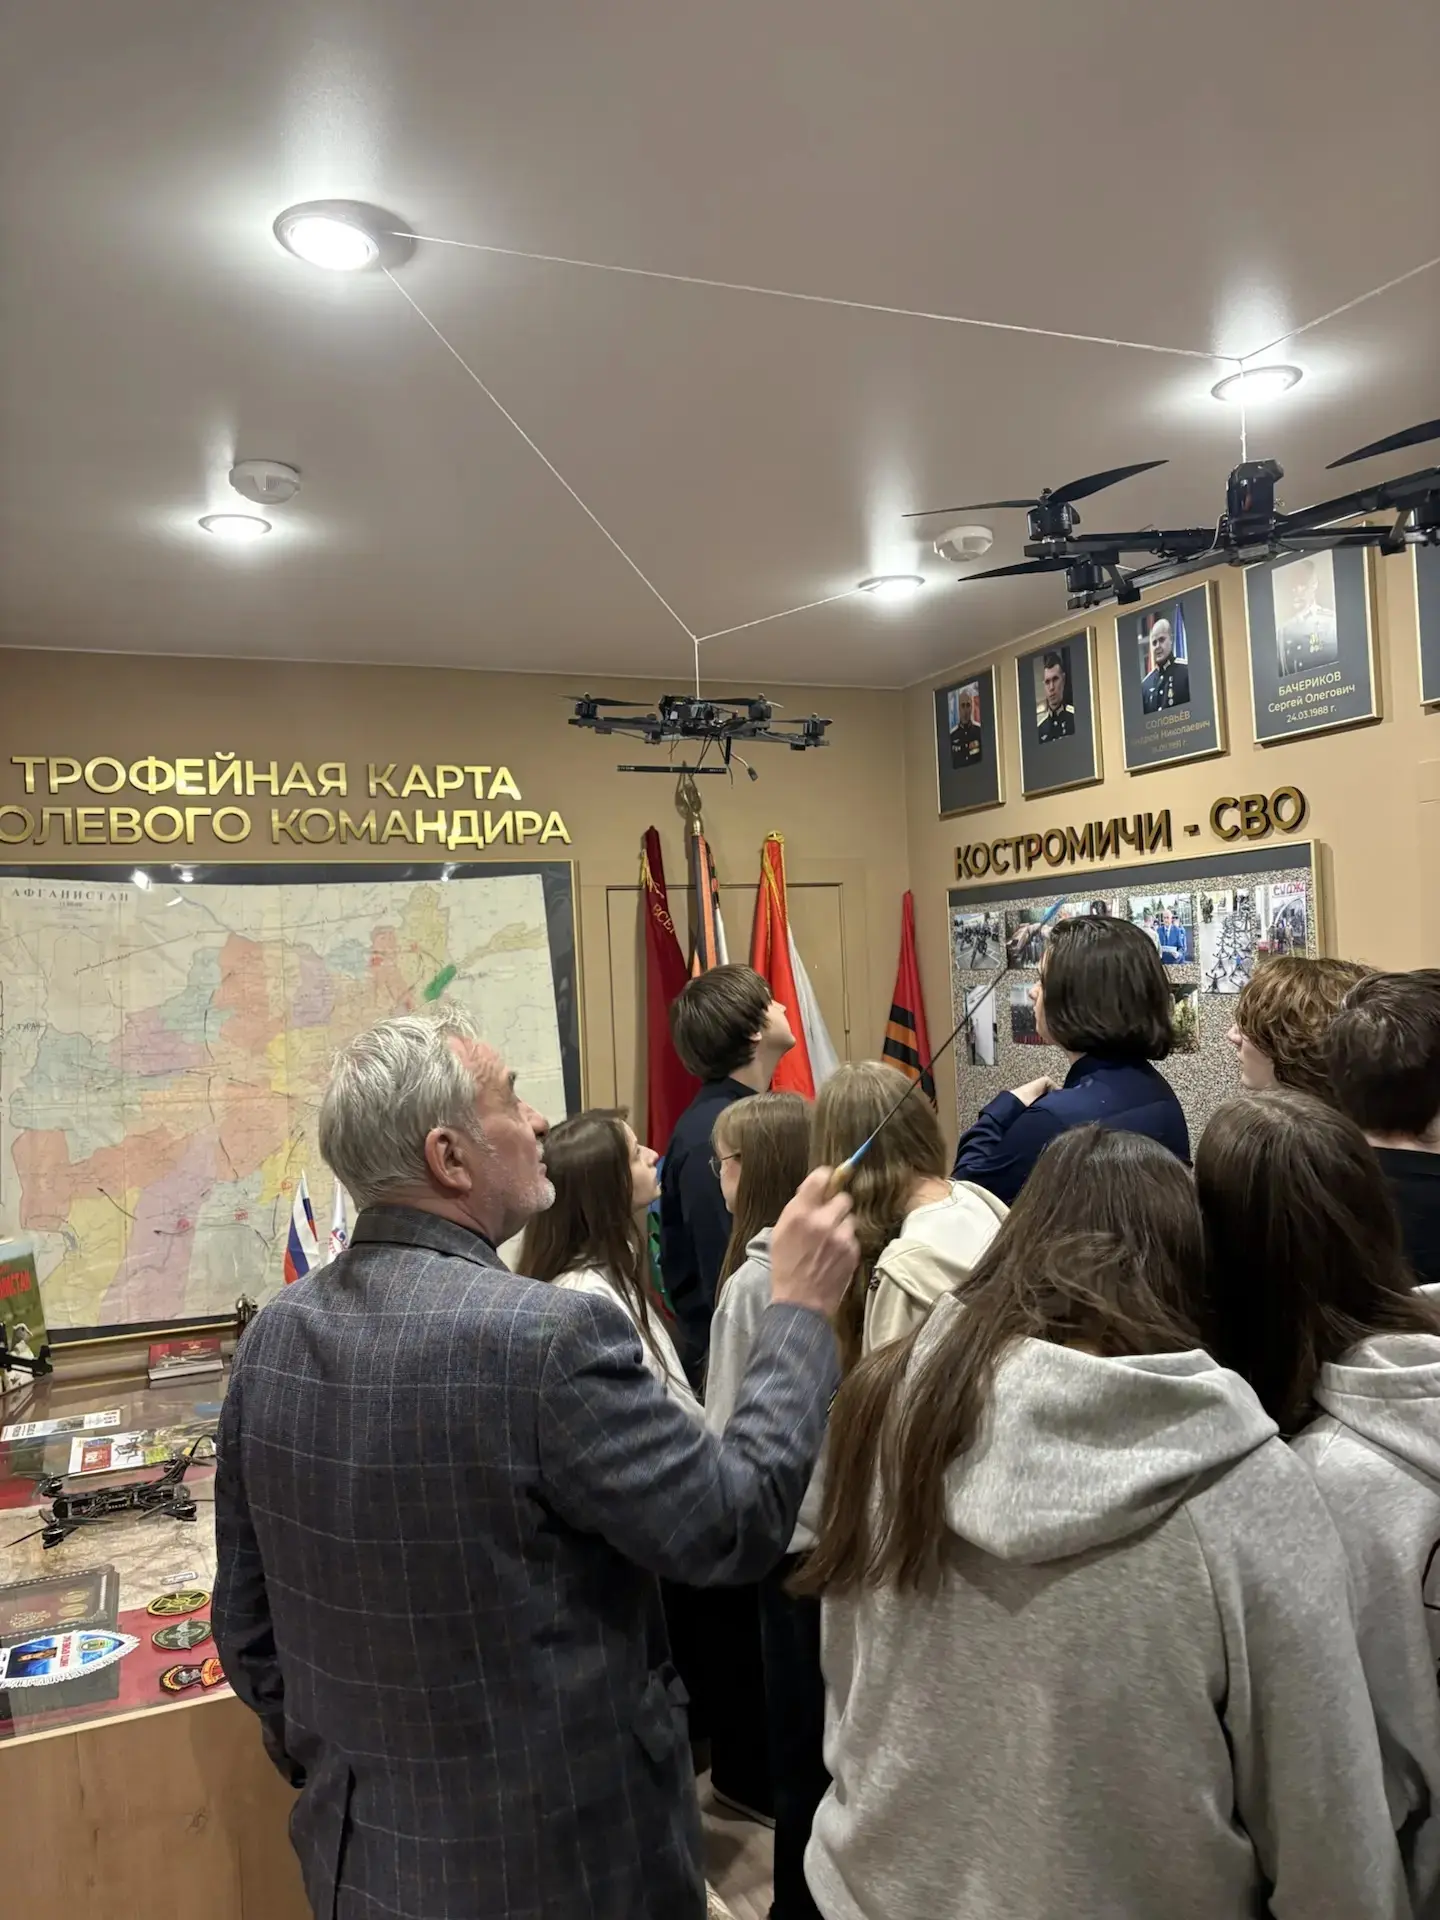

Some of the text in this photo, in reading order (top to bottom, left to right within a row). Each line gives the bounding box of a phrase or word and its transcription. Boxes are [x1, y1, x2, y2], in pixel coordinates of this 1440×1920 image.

[1267, 684, 1356, 713] Сергей Олегович
[1278, 671, 1342, 697] БАЧЕРИКОВ
[1286, 704, 1337, 723] 24.03.1988 г.
[11, 752, 522, 800] ТРОФЕЙНАЯ КАРТА
[0, 805, 572, 851] ОЛЕВОГО КОМАНДИРА
[954, 809, 1172, 881] КОСТРОМИЧИ
[1209, 785, 1307, 842] СВО
[12, 888, 129, 902] АФГАНИСТАН
